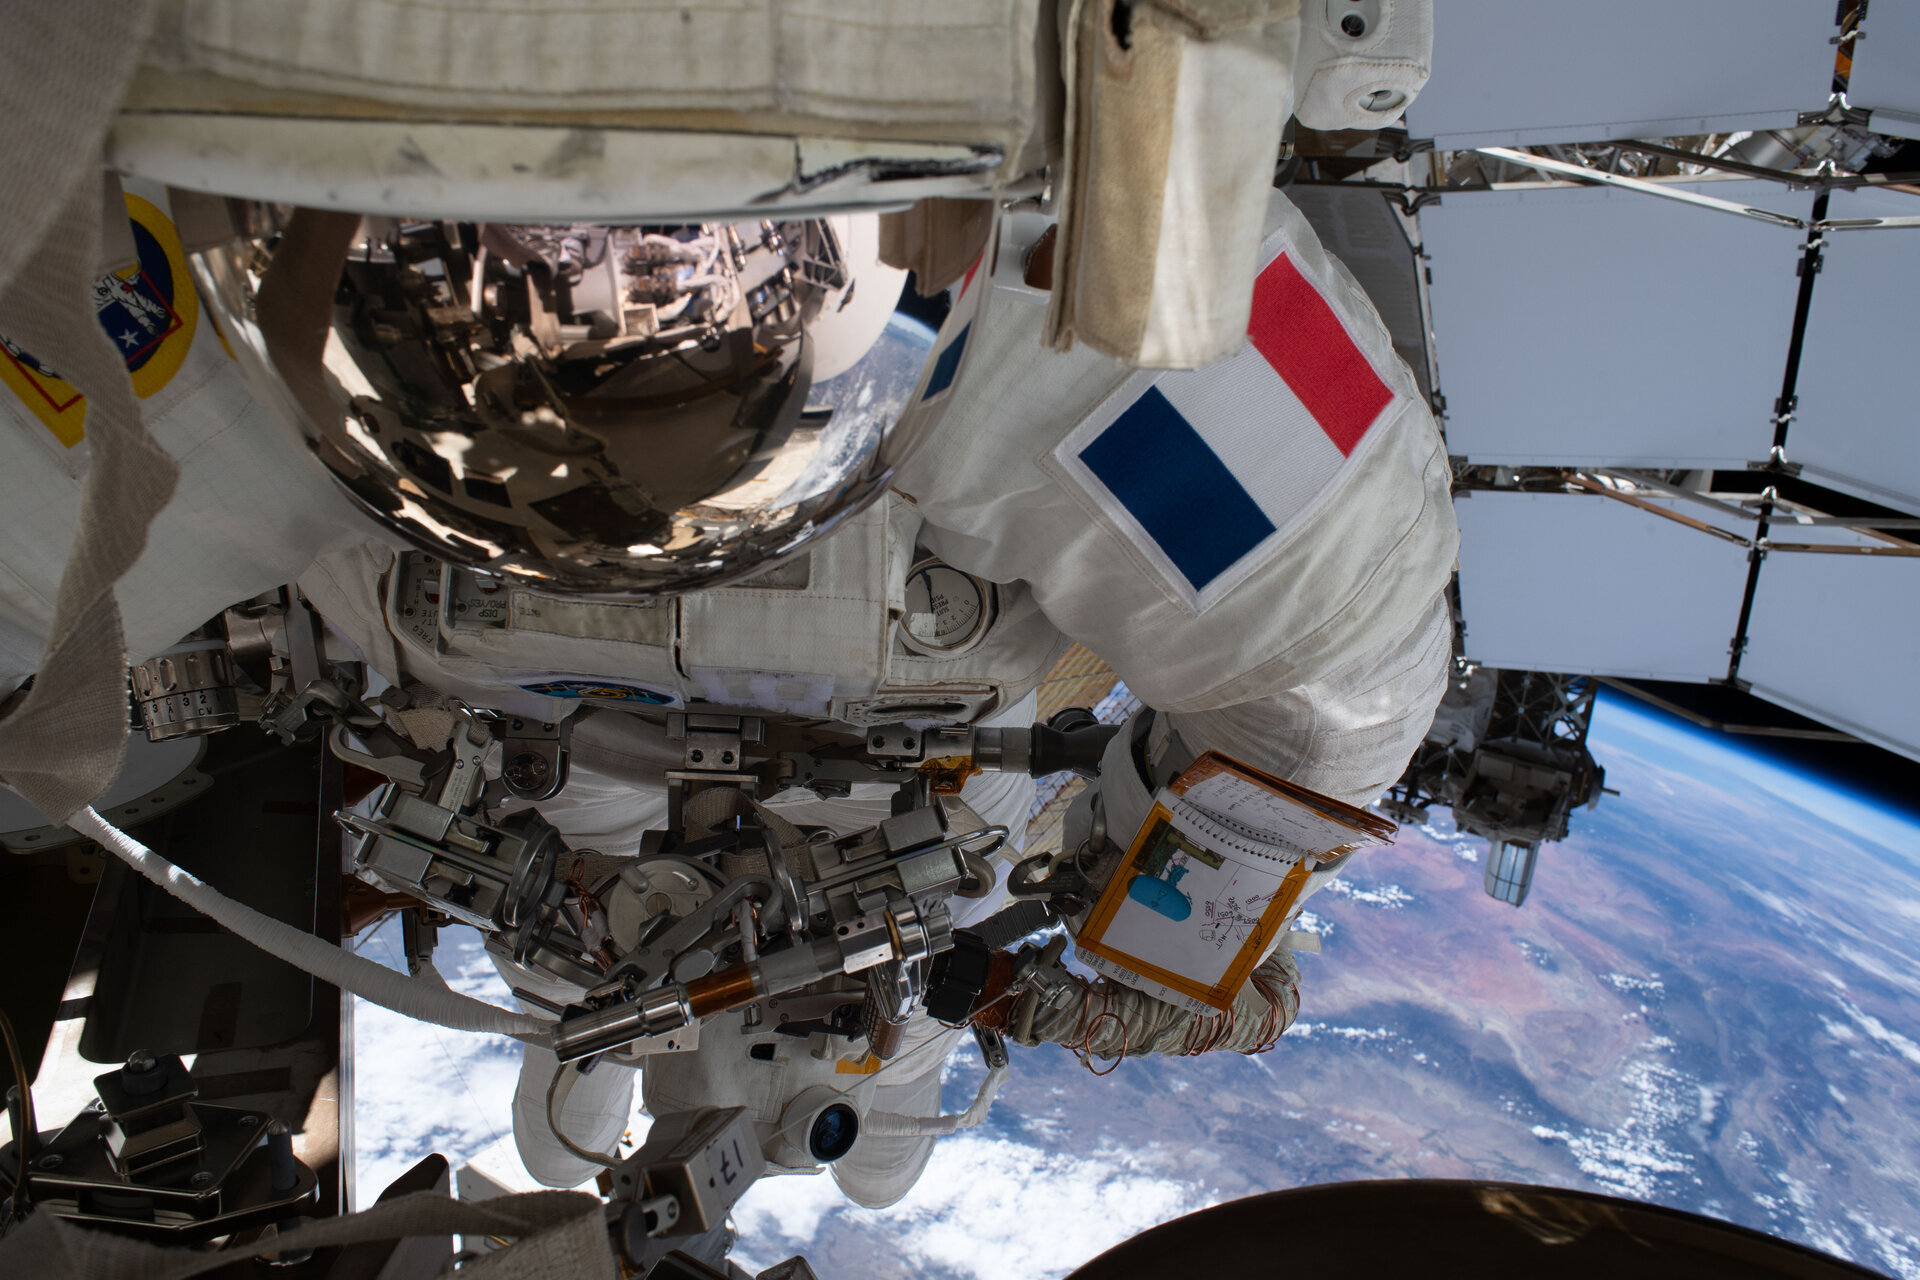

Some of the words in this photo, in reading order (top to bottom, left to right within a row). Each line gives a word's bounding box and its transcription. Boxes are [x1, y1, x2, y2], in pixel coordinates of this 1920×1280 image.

[427, 569, 441, 577] OW
[468, 599, 507, 609] PRO/YES
[478, 609, 498, 618] DISP
[412, 625, 434, 644] FREQ
[183, 697, 190, 706] 3
[200, 694, 207, 704] 2
